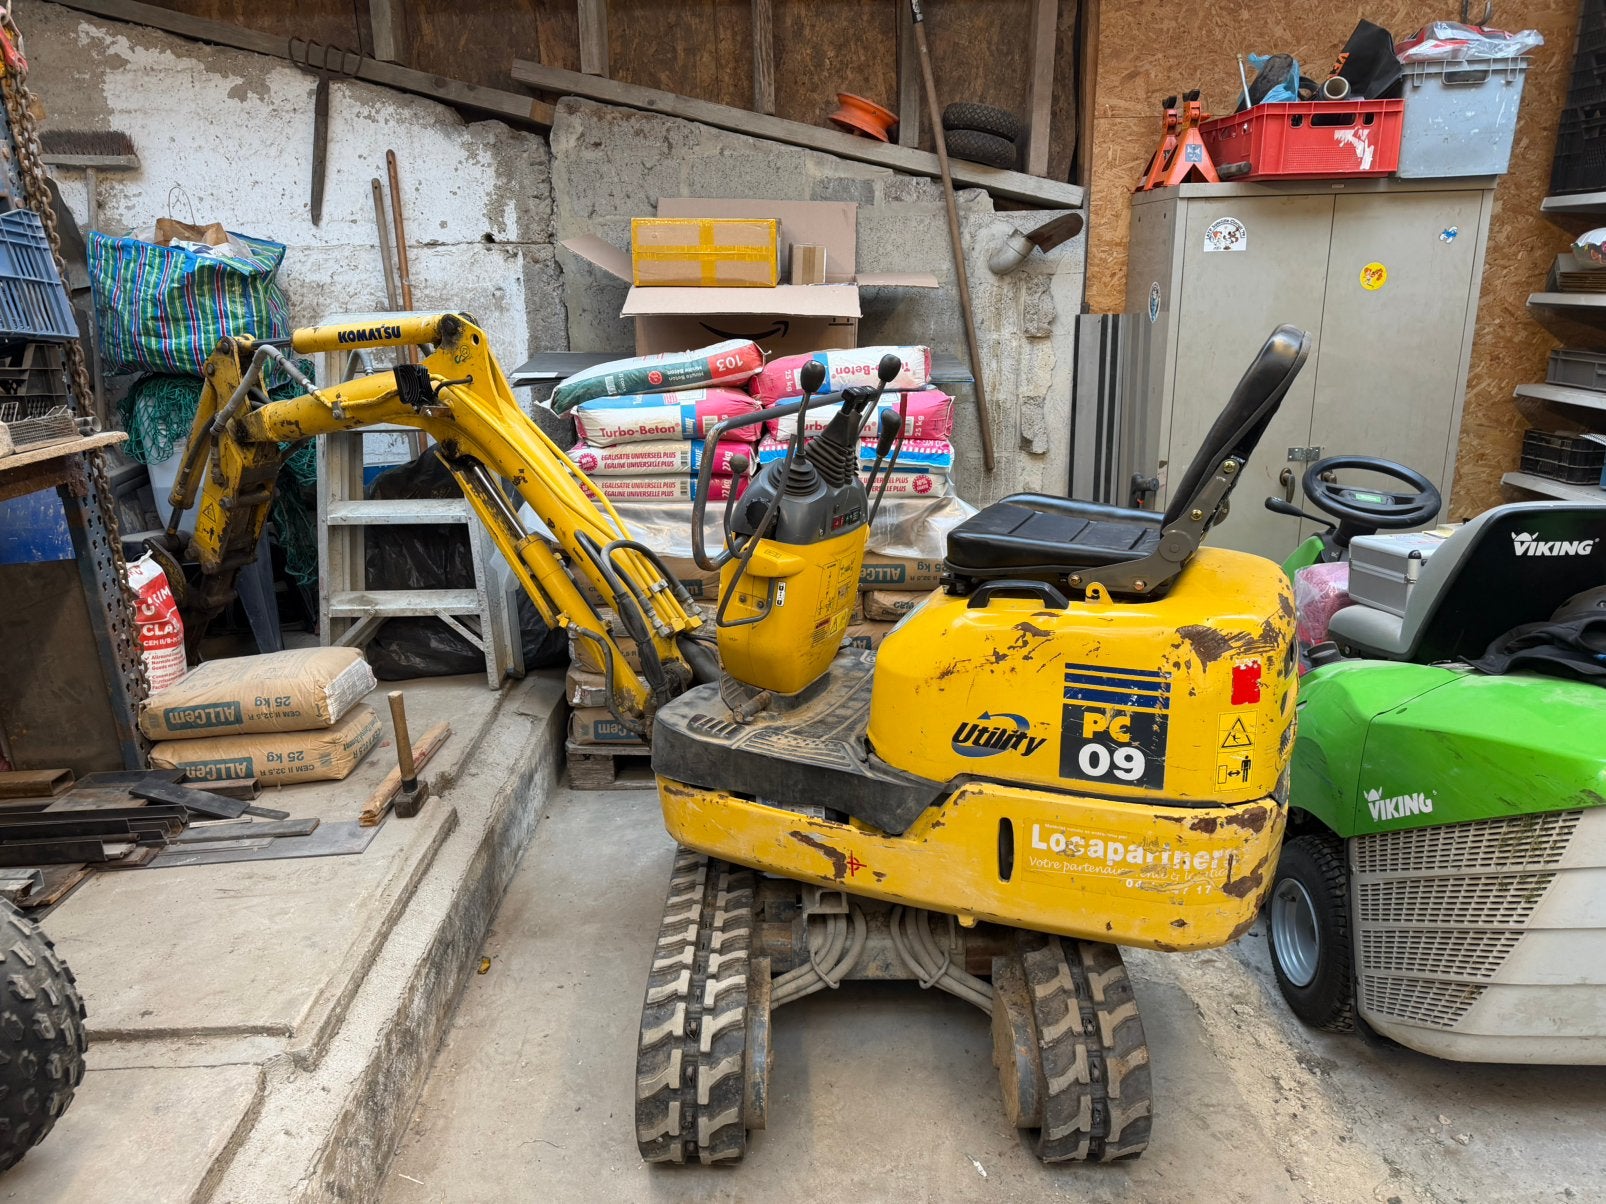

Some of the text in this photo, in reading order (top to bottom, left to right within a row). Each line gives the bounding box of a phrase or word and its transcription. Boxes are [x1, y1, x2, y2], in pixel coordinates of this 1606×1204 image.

[338, 325, 401, 343] KOMATSU
[716, 354, 744, 372] 103
[914, 427, 922, 437] 25
[722, 450, 733, 471] 22 kg
[1513, 540, 1594, 556] VIKING
[860, 567, 900, 581] ALLCe
[917, 561, 931, 572] kg
[254, 696, 291, 707] 25 kg
[169, 705, 235, 724] ALLCem
[248, 713, 254, 721] R
[1083, 711, 1131, 743] PC
[953, 721, 1047, 757] Utility
[267, 750, 305, 763] 25 kg
[1078, 743, 1146, 781] 09
[268, 766, 286, 776] 32,5
[298, 764, 314, 772] CEM
[1368, 791, 1433, 823] VIKING
[1028, 855, 1061, 870] Votre
[1063, 861, 1130, 877] partenair
